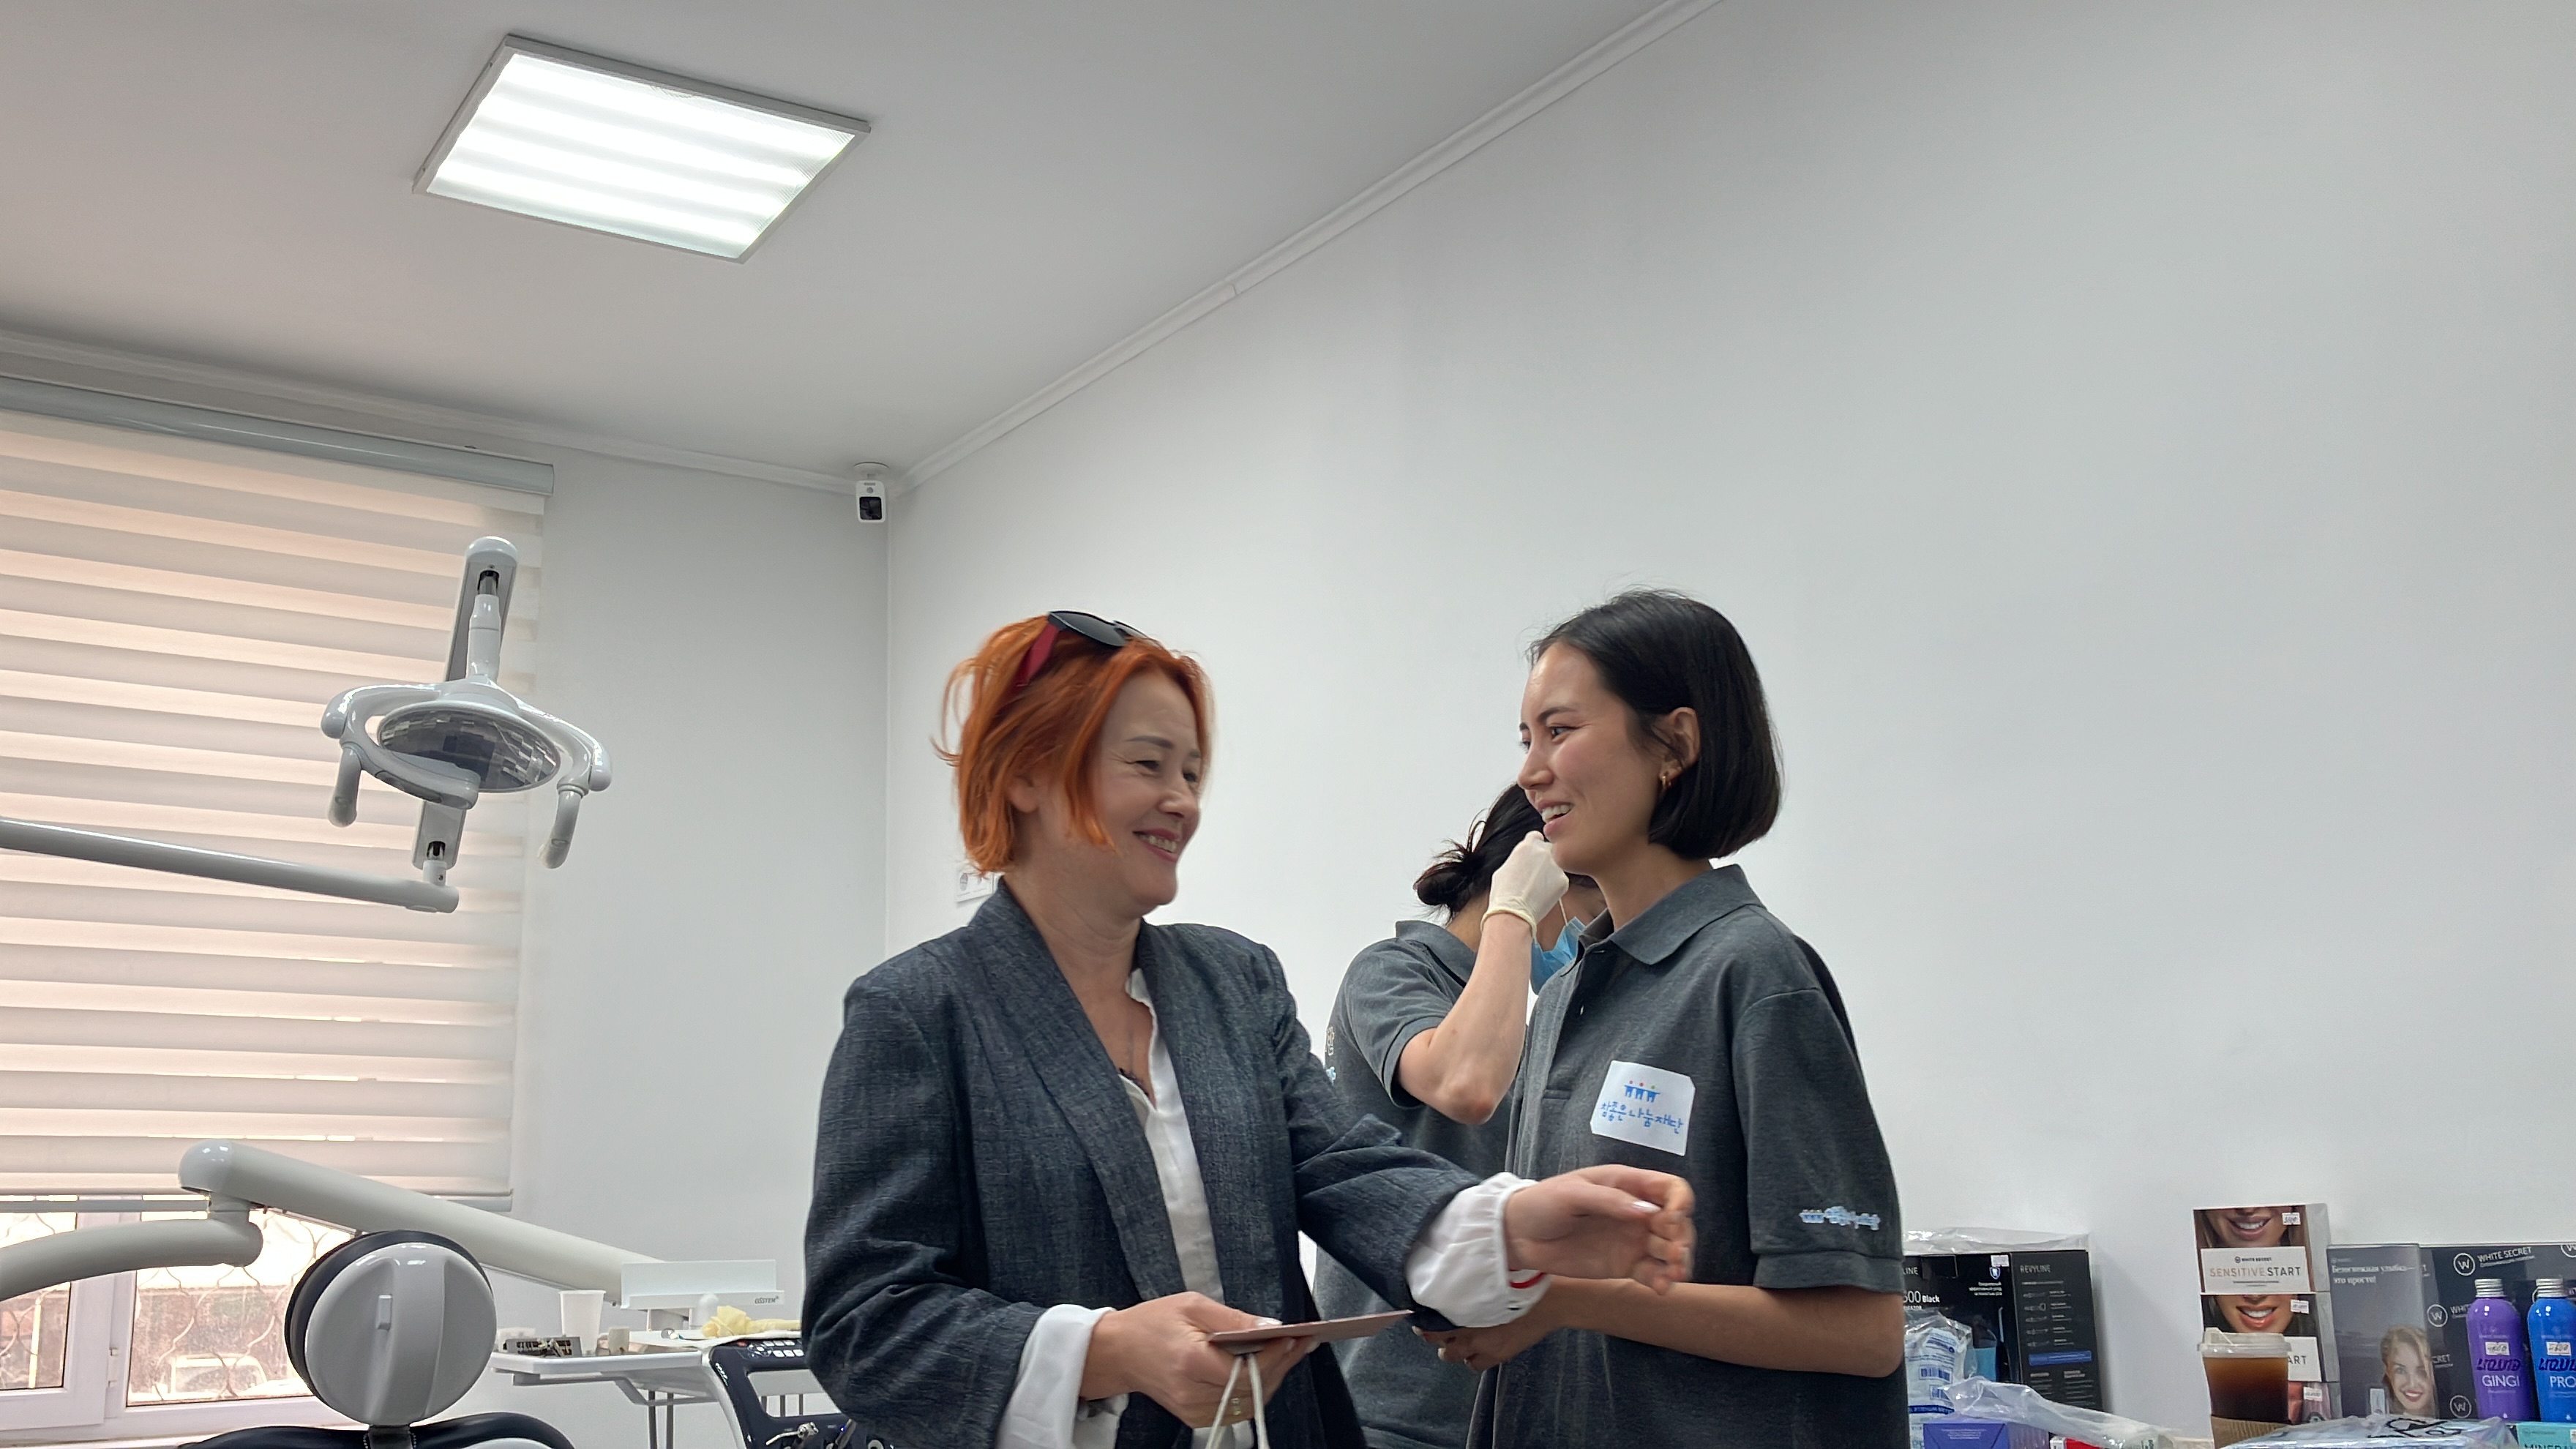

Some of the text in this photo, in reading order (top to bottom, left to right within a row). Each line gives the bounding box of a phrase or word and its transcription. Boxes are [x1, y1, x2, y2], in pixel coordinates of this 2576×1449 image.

[2477, 1251, 2503, 1262] WHITE
[2504, 1246, 2532, 1258] SECRET
[1902, 1267, 1919, 1275] LINE
[2020, 1264, 2051, 1273] REVYLINE
[2209, 1267, 2301, 1277] SENSITIVE START
[1922, 1294, 1940, 1303] Black
[2450, 1303, 2471, 1314] WHIT
[2288, 1355, 2307, 1365] ART
[2431, 1354, 2451, 1363] CRET
[2482, 1375, 2520, 1387] GINGI
